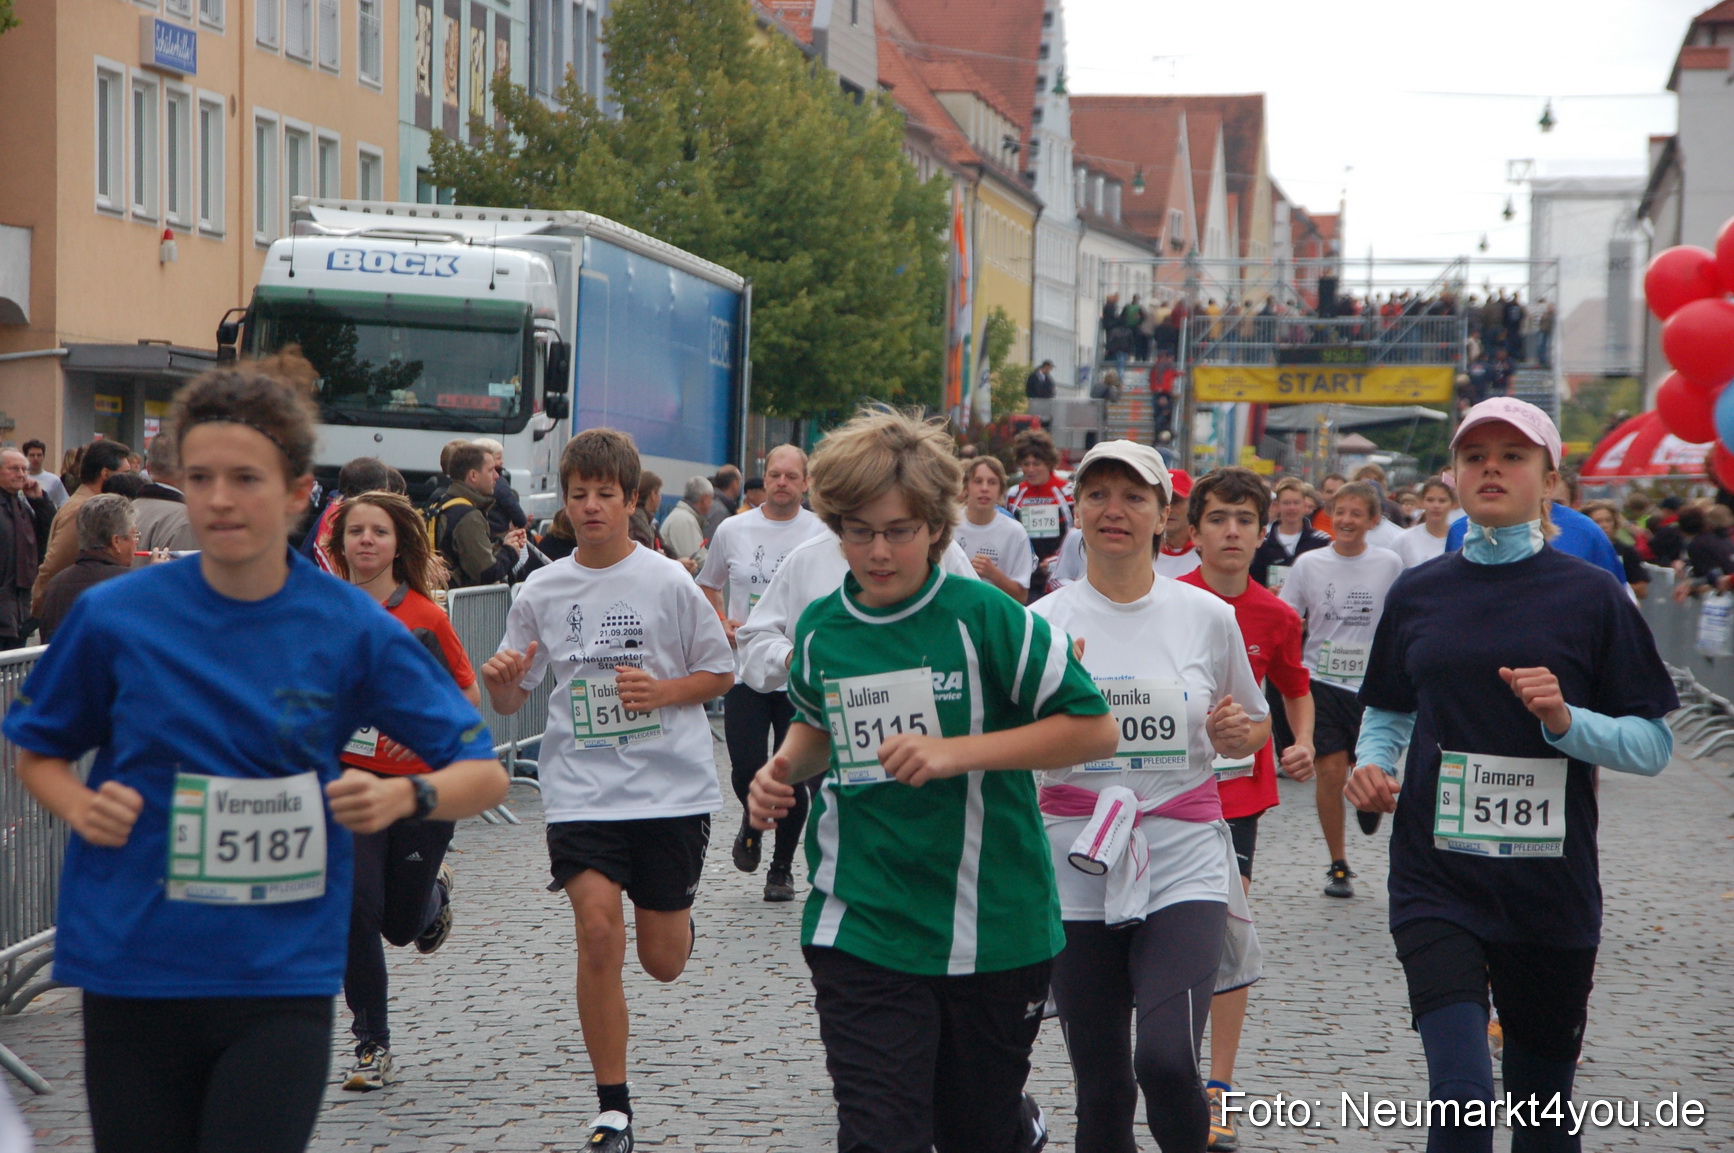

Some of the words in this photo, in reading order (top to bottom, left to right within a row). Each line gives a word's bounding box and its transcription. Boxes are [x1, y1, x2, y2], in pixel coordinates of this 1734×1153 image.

[326, 248, 461, 278] BOCK
[1277, 372, 1368, 394] START
[600, 628, 643, 637] 21.09.2008
[1331, 658, 1364, 671] 5191
[931, 671, 963, 691] RA
[590, 684, 620, 698] Tobia
[847, 687, 889, 708] Julian
[934, 691, 962, 702] ervice
[1100, 687, 1150, 706] Monika
[575, 706, 581, 717] S
[832, 721, 838, 736] S
[854, 713, 928, 749] 5115
[1117, 715, 1176, 742] 069
[1143, 756, 1187, 765] PFLEIDERER
[1473, 764, 1535, 787] Tamara
[216, 789, 302, 815] Veronika
[1443, 791, 1450, 805] S
[1474, 796, 1549, 826] 5181
[177, 824, 187, 842] S
[217, 825, 313, 862] 5187
[1513, 843, 1560, 852] PFLEIDERER
